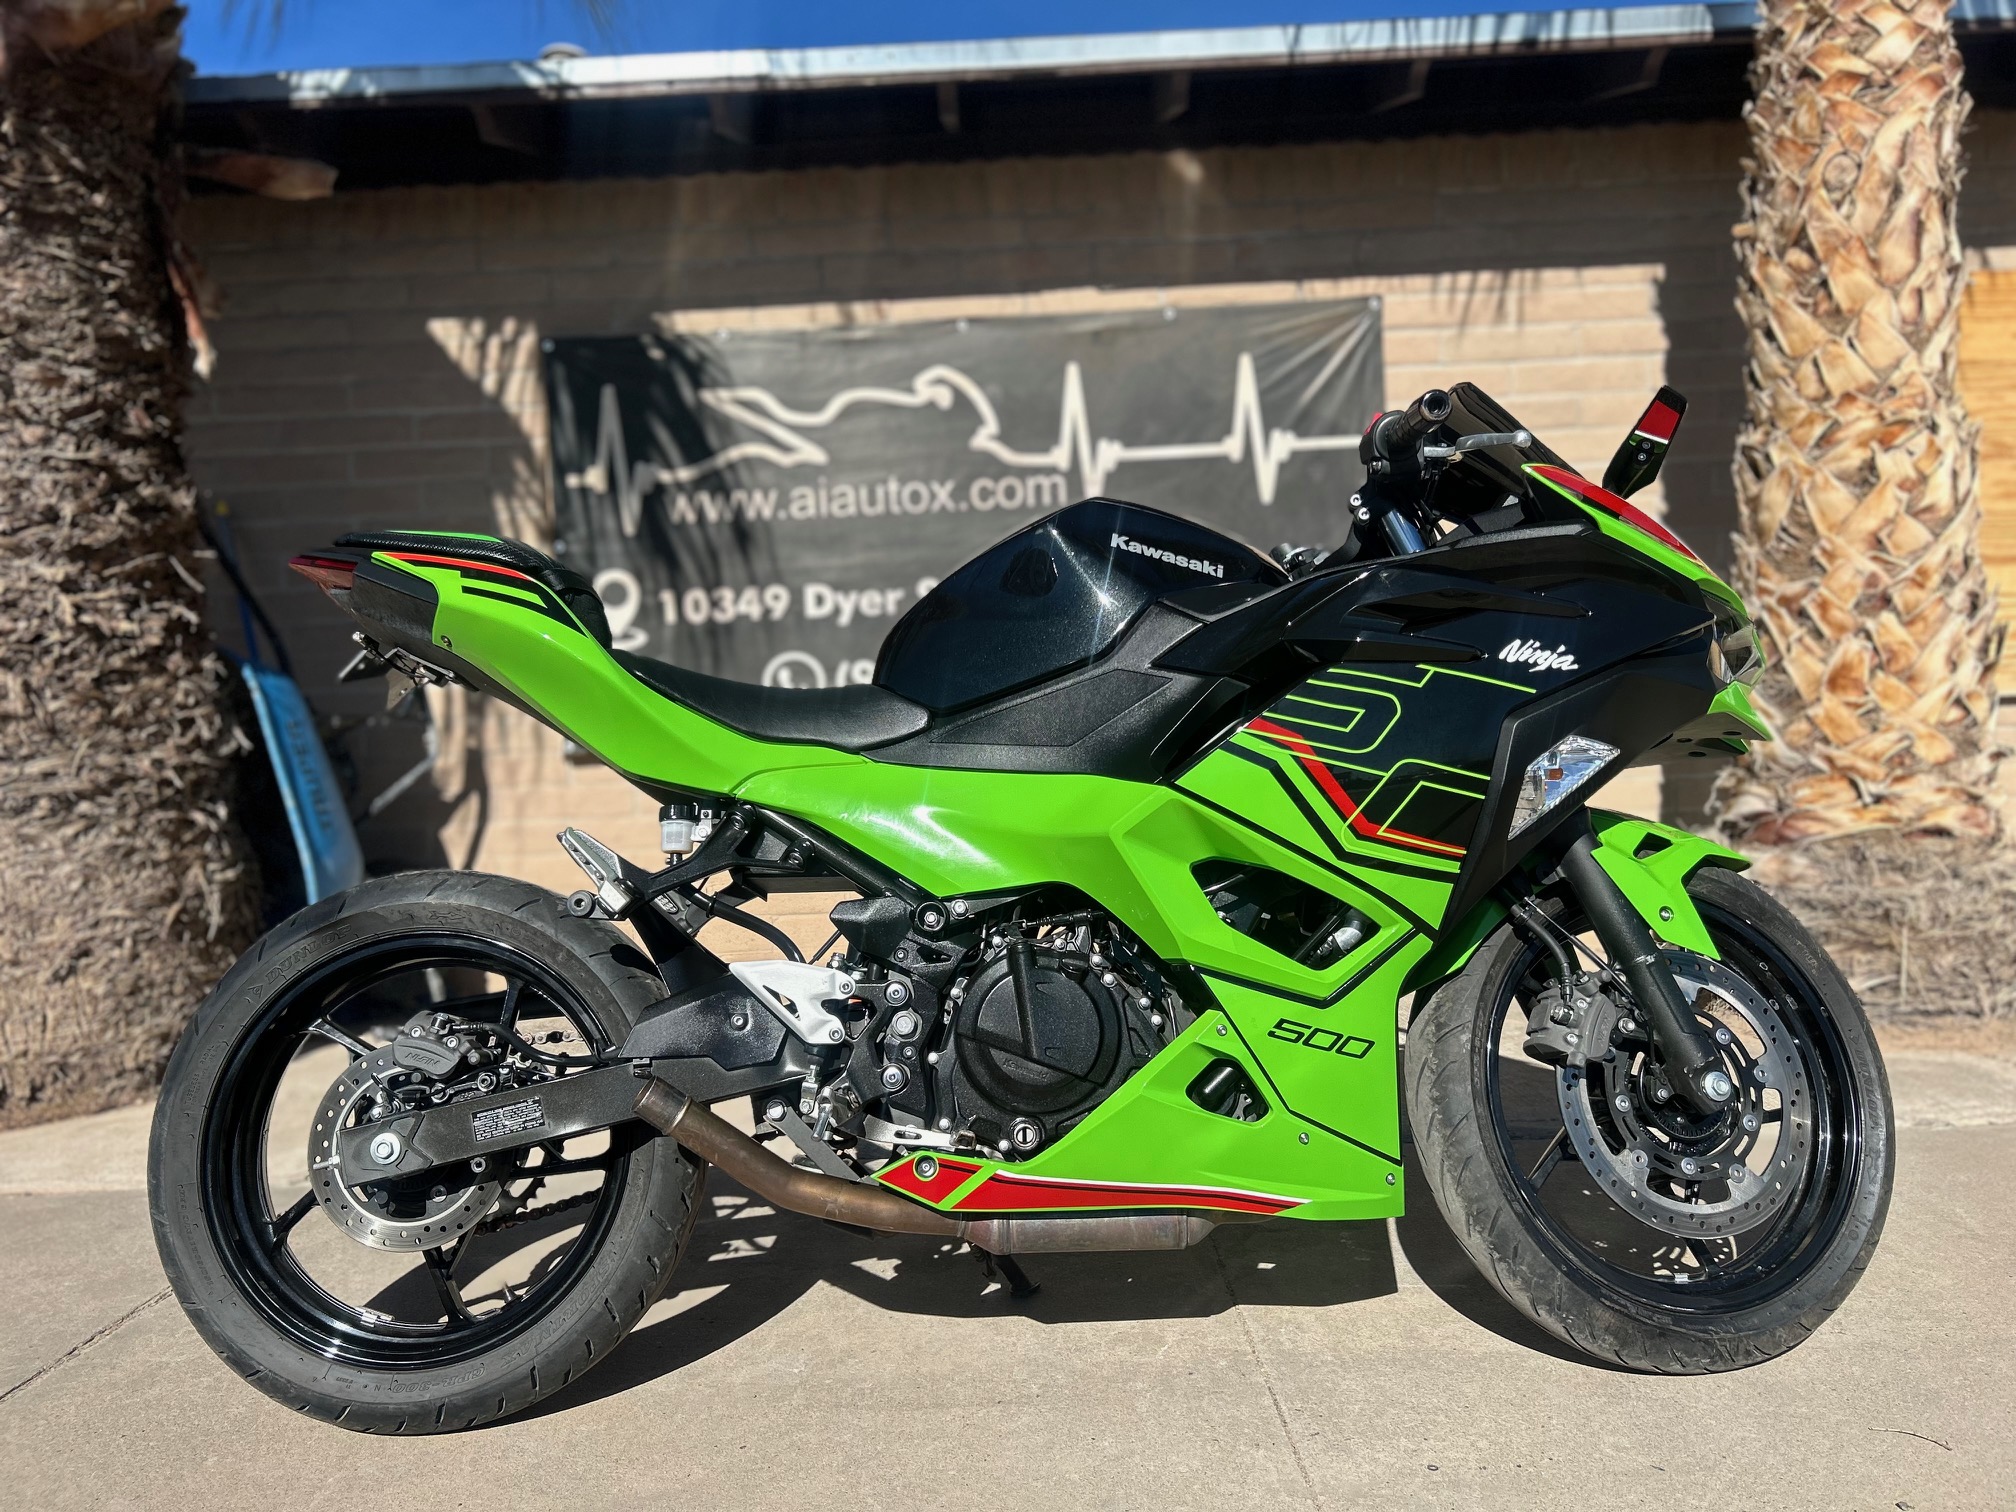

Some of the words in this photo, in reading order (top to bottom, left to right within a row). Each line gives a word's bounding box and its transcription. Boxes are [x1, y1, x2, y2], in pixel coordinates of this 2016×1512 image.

[671, 473, 1067, 525] www.aiautox.com
[1110, 532, 1224, 579] Kawasaki
[658, 582, 791, 626] 10349
[802, 581, 904, 627] Dyer
[1498, 638, 1579, 672] Ninja
[1267, 1017, 1376, 1060] 500
